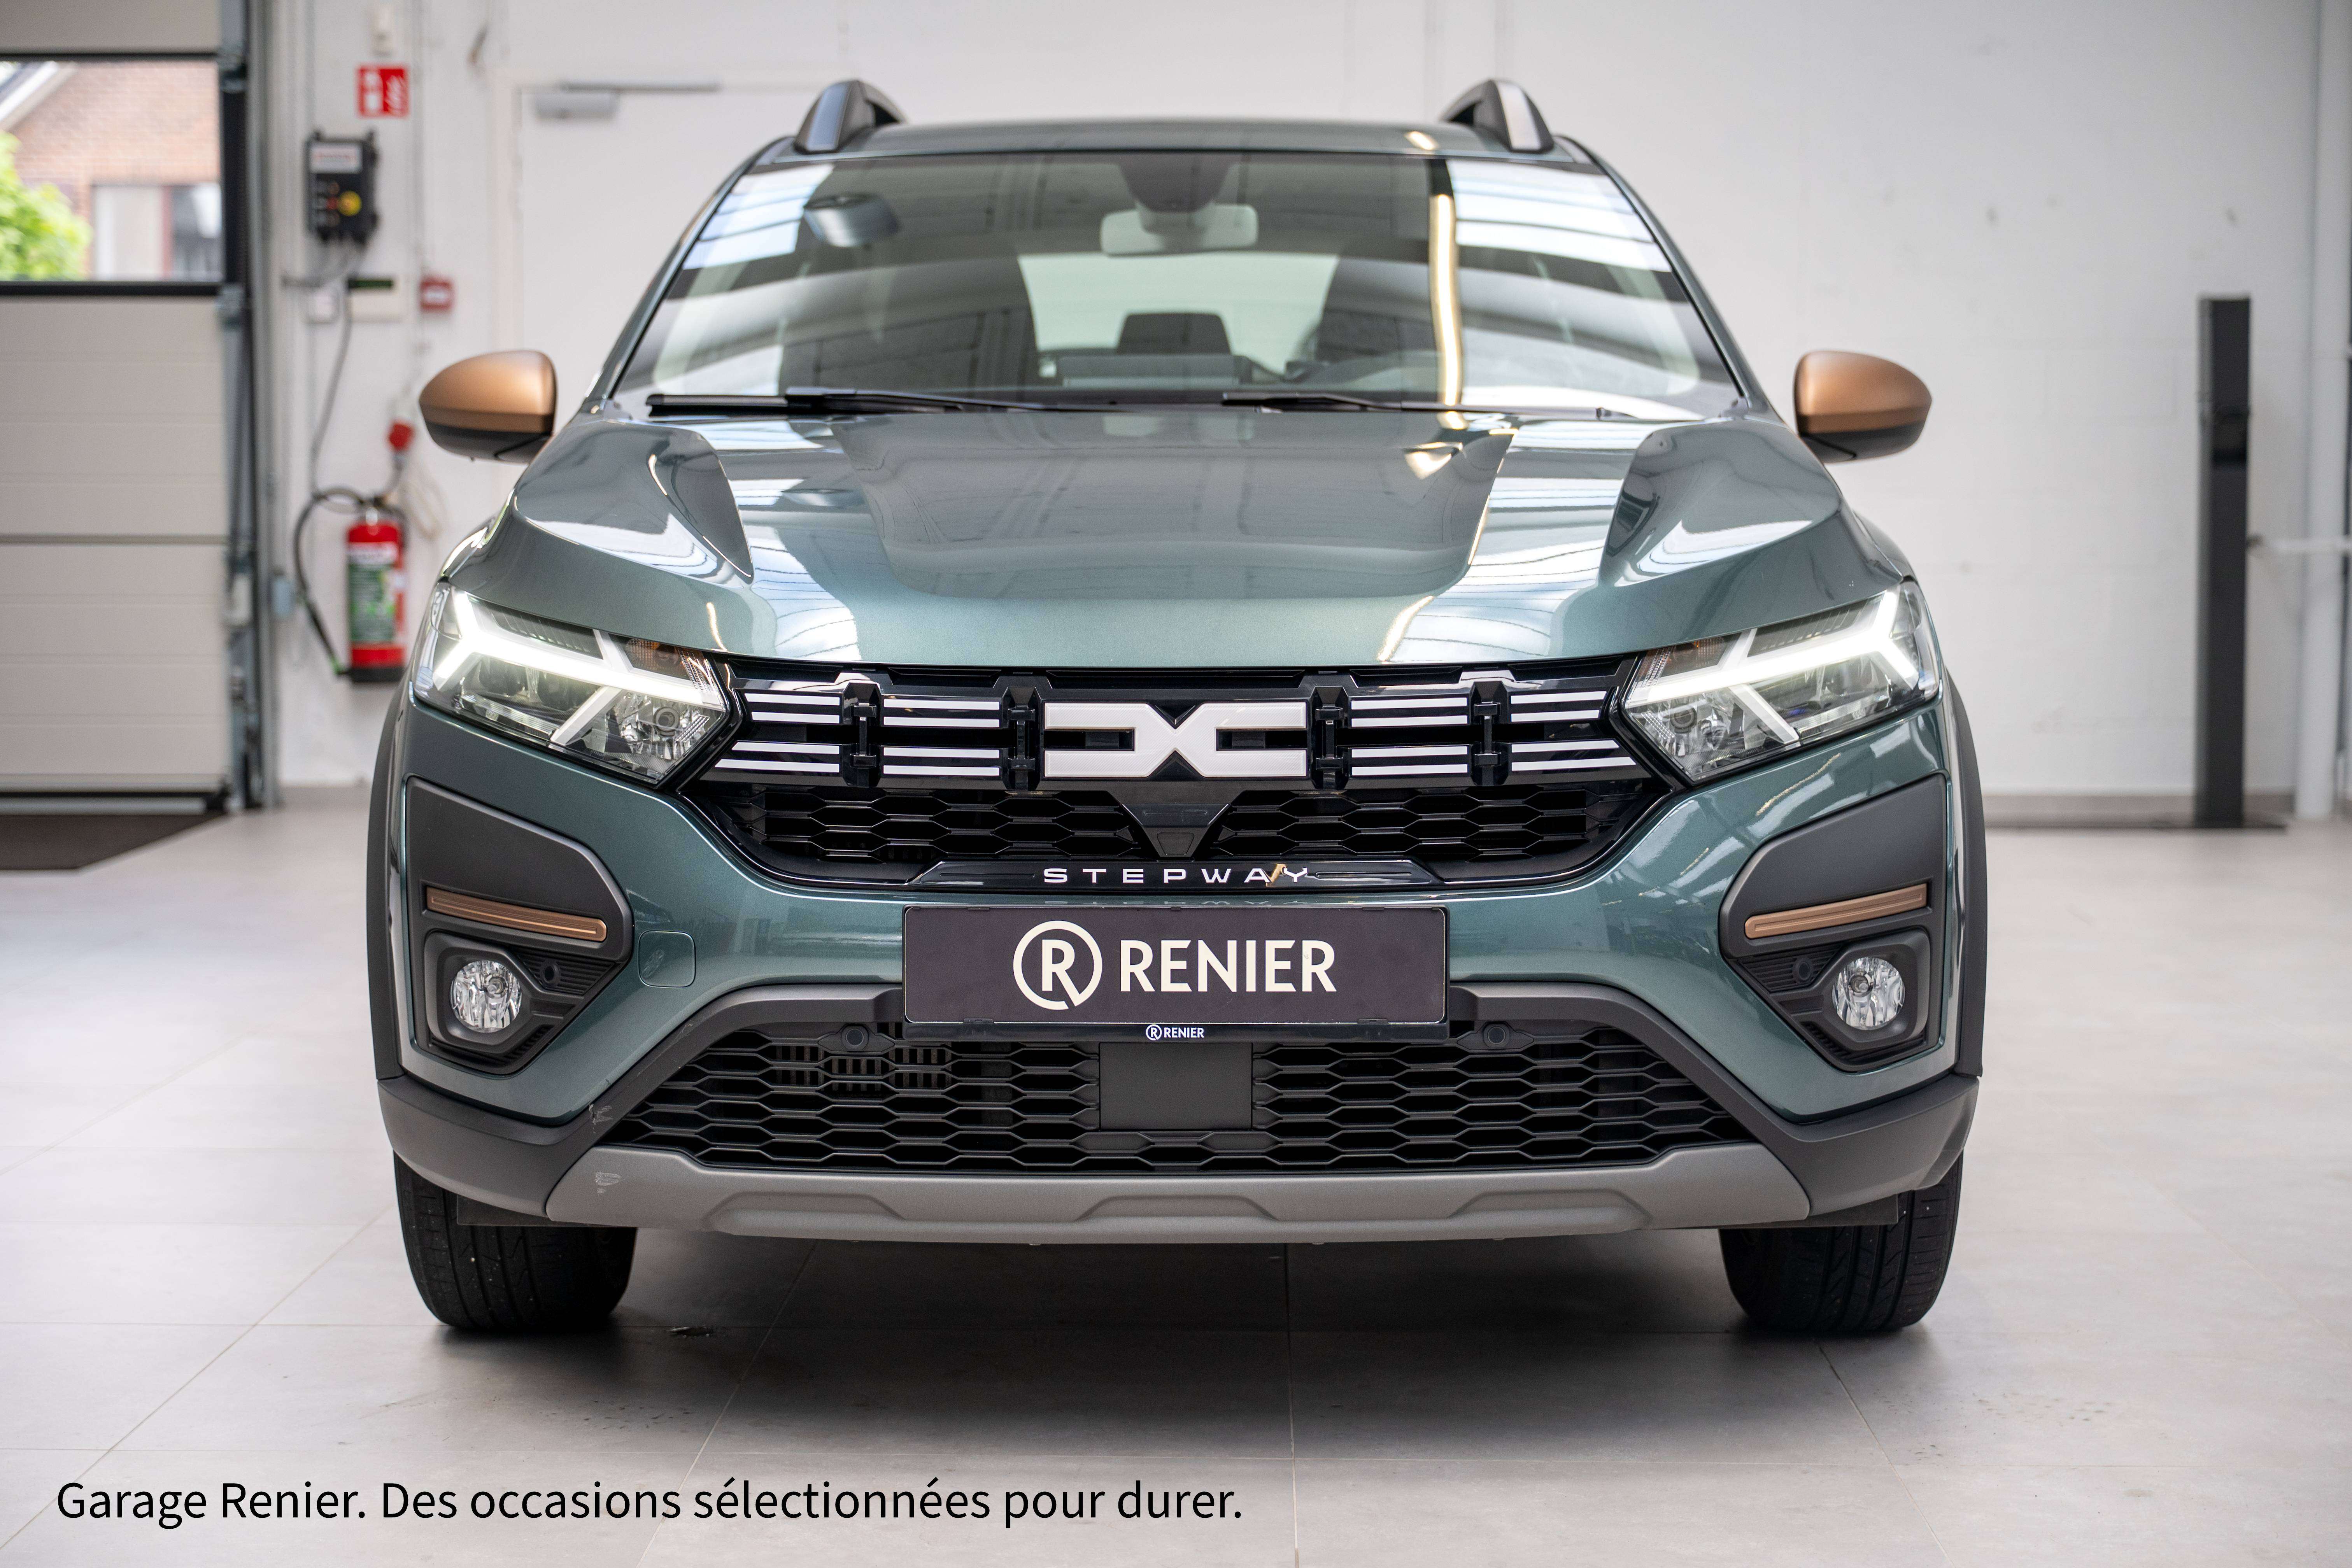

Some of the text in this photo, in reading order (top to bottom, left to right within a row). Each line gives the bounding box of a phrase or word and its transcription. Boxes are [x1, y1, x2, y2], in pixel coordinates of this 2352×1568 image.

[1044, 867, 1308, 883] STEPWAY
[1120, 939, 1337, 992] RENIER
[1164, 1027, 1204, 1038] RENIER
